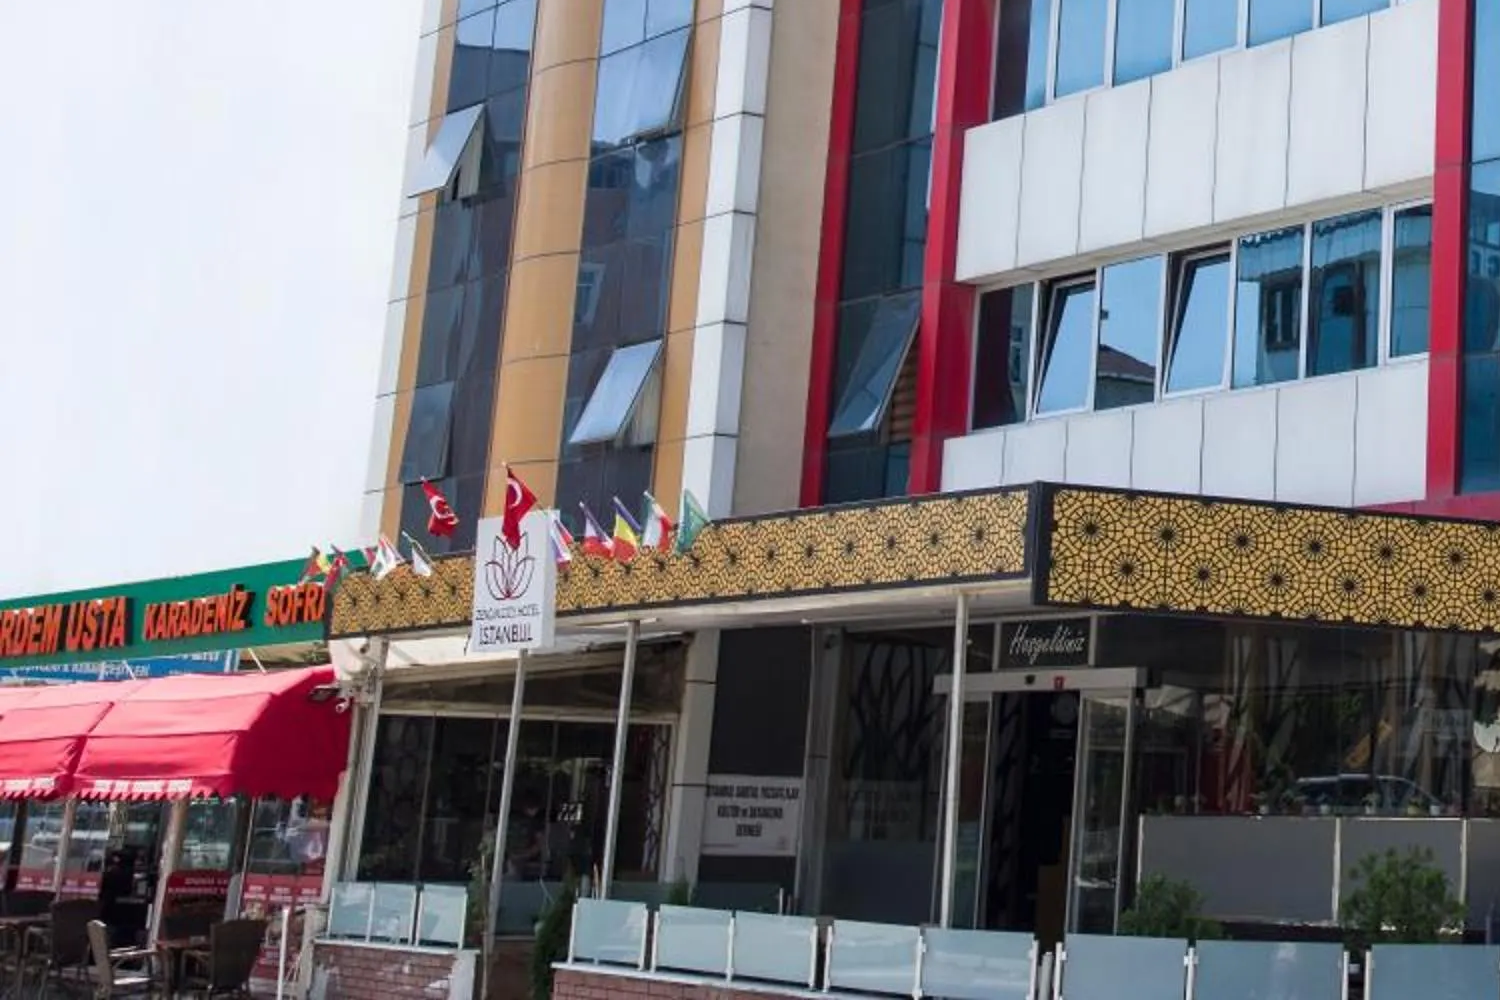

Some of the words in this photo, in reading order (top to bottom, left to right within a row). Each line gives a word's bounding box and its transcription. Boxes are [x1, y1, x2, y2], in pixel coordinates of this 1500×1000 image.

[0, 604, 62, 657] RDEM
[66, 596, 126, 652] USTA
[142, 584, 249, 641] KARADENİZ
